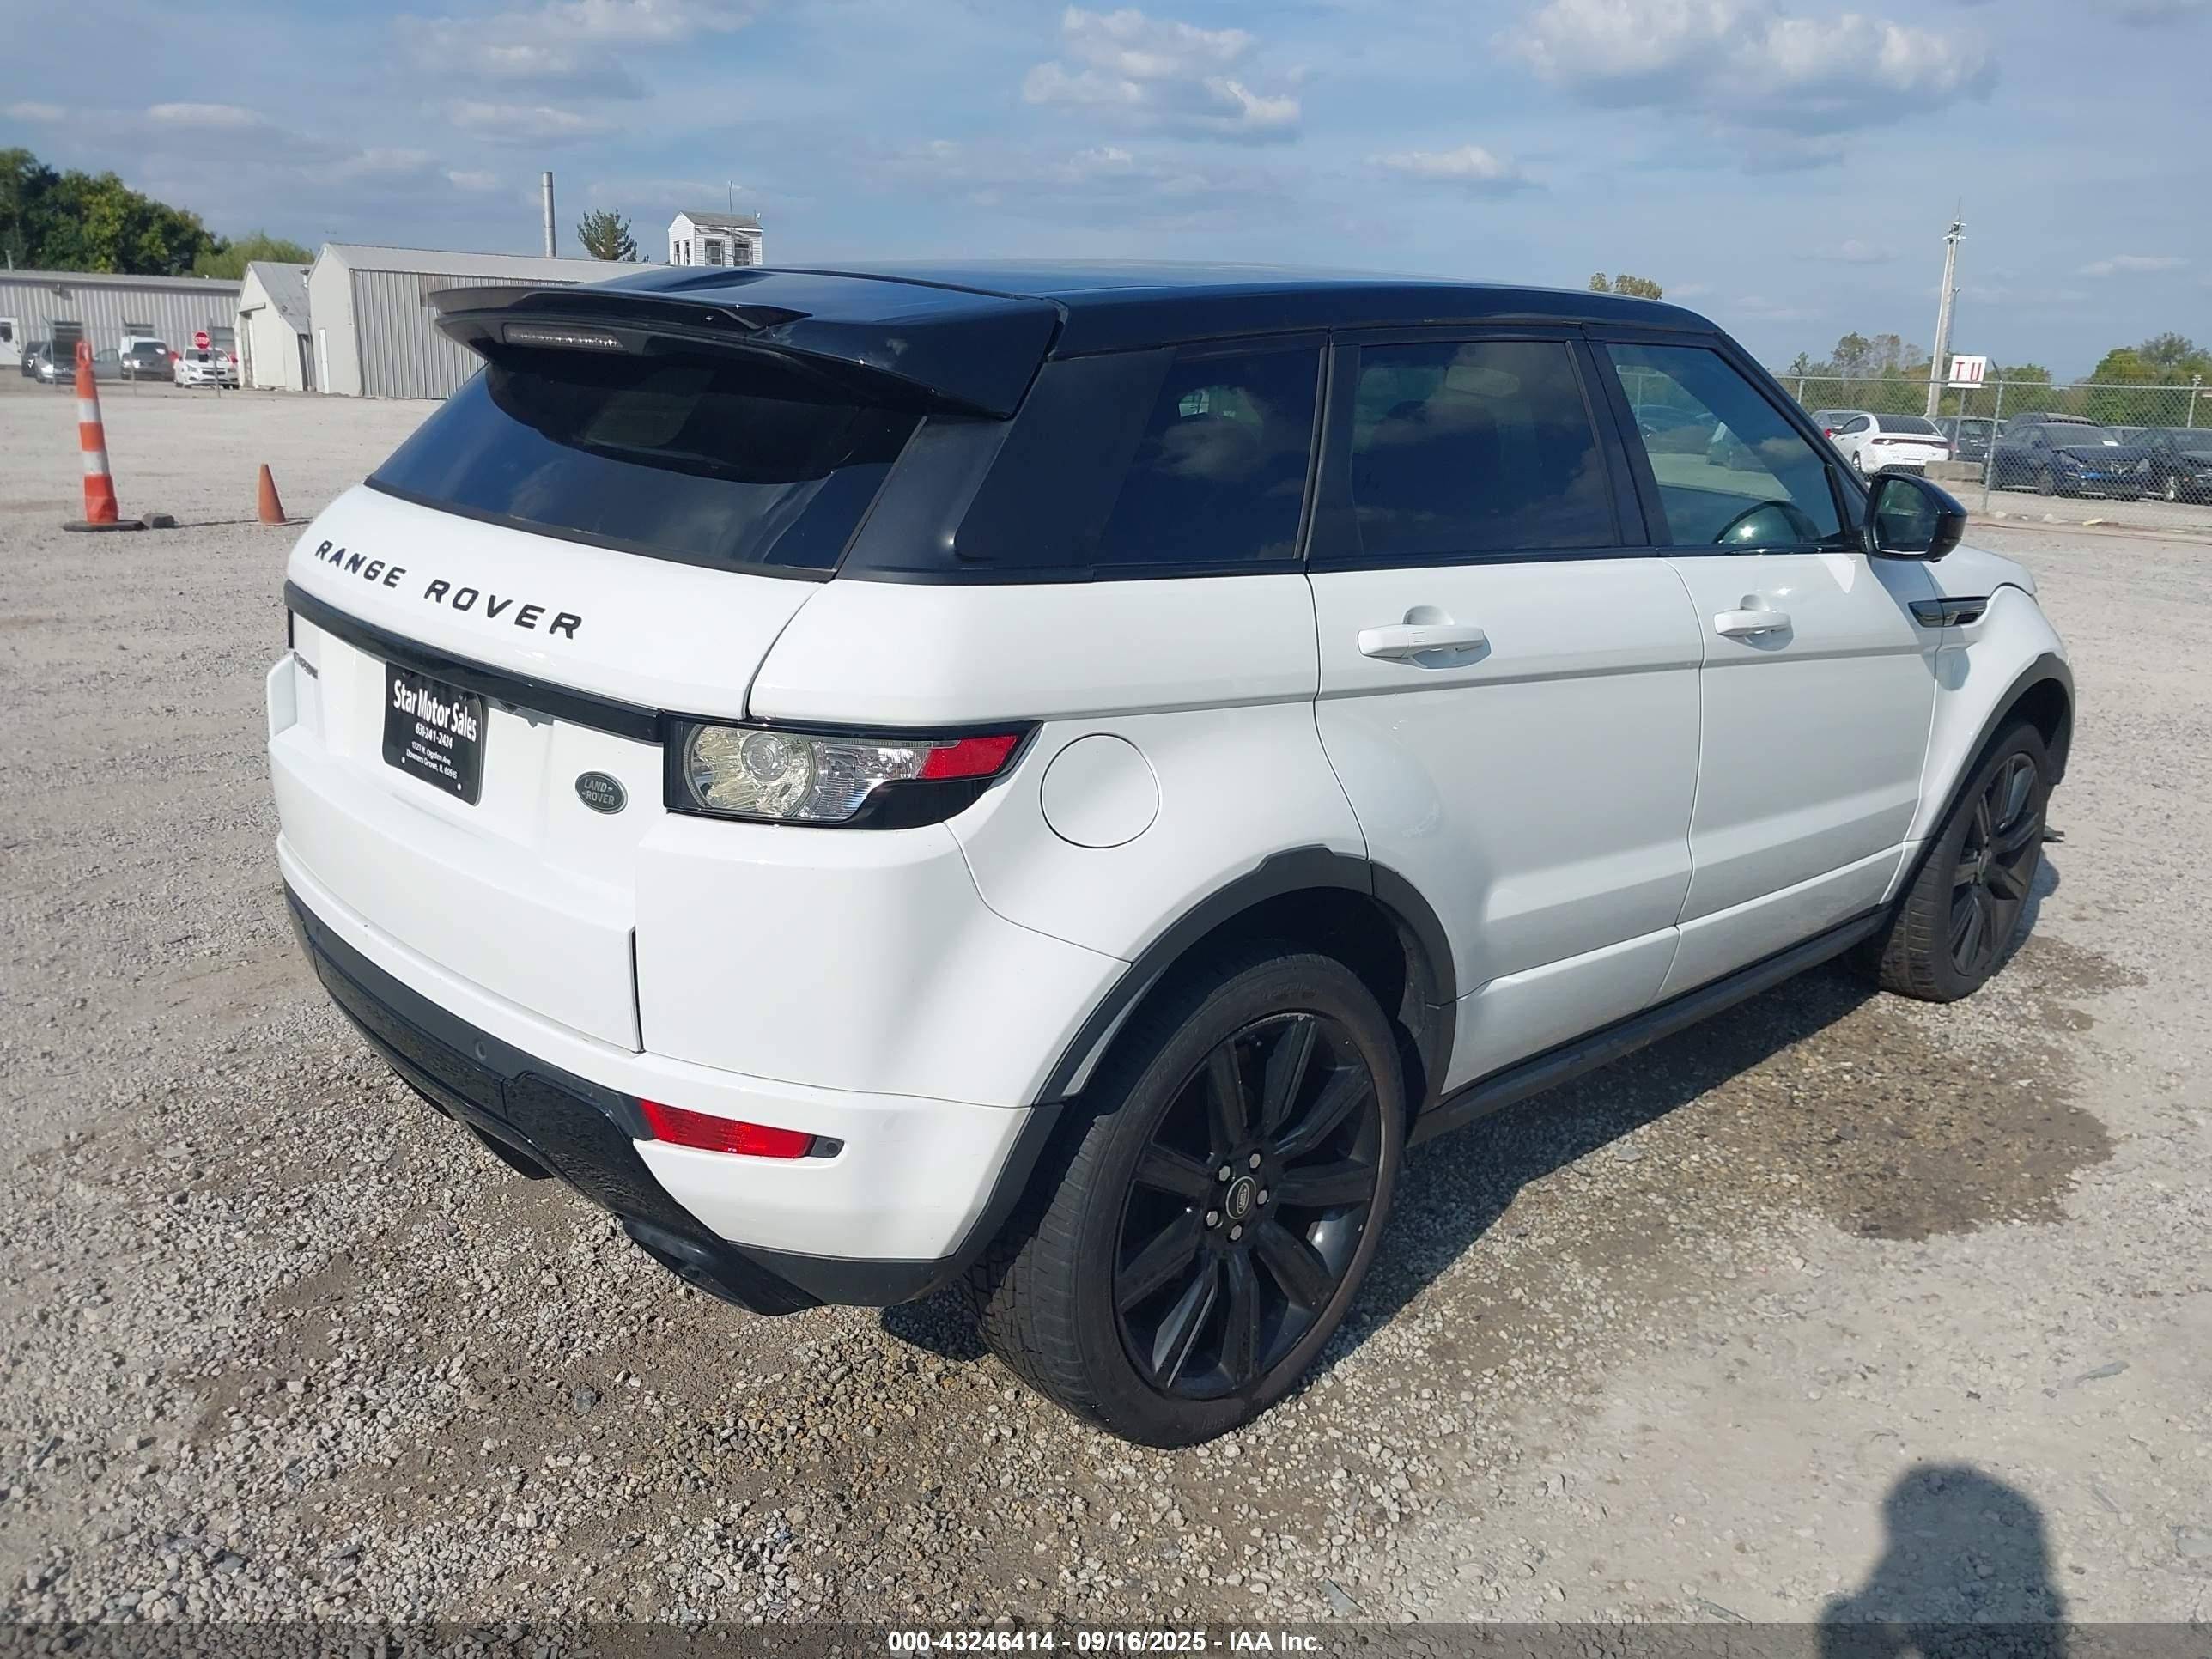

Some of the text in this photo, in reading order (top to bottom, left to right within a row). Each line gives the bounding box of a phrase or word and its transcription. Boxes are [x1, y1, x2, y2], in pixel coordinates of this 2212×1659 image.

[314, 540, 582, 640] RANGE ROVER
[393, 679, 477, 742] Star Motor Sales
